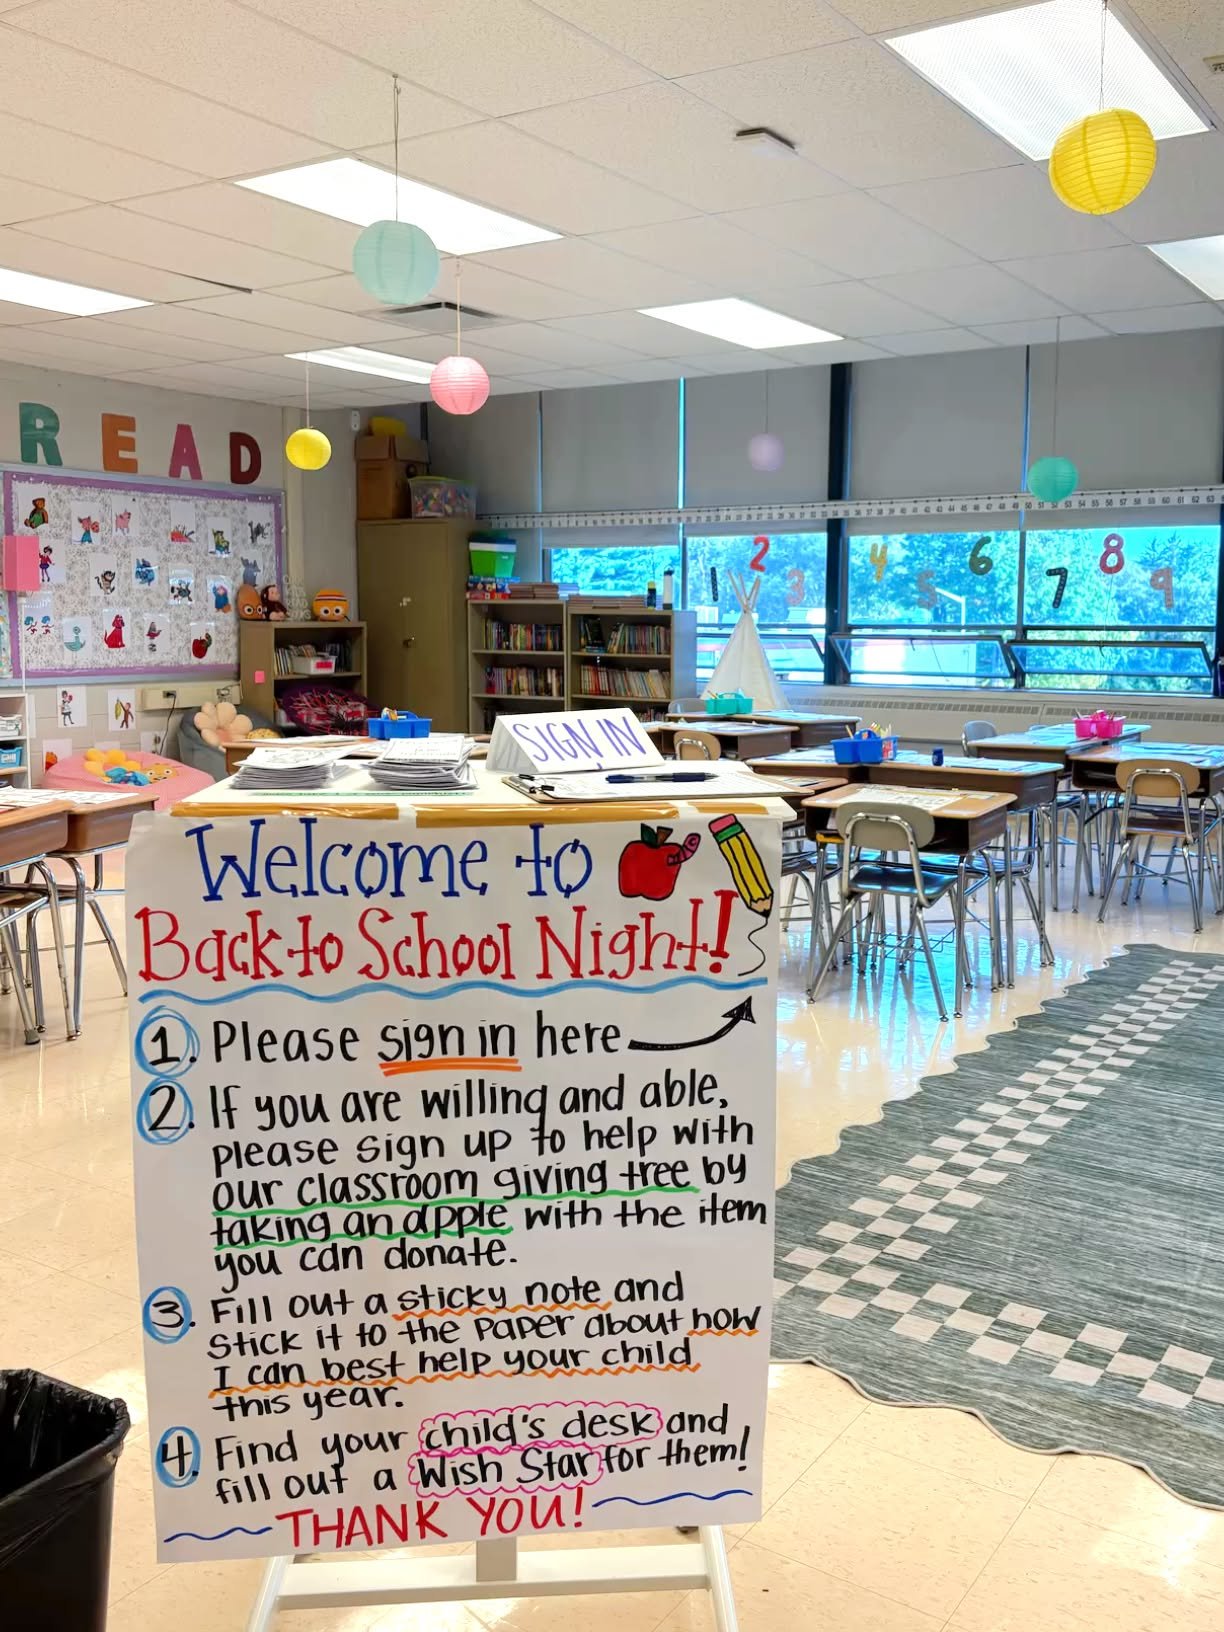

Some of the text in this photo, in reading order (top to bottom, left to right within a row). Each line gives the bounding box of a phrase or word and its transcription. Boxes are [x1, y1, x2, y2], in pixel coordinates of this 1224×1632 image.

[19, 402, 262, 485] READ
[1025, 501, 1033, 509] 50
[1038, 501, 1045, 509] 51
[1064, 500, 1072, 508] 53
[1078, 499, 1086, 507] 54
[1091, 499, 1100, 507] 55
[1105, 498, 1113, 507] 56
[1119, 498, 1127, 506] 57
[1162, 496, 1170, 504] 60
[1177, 496, 1184, 504] 61
[1191, 495, 1200, 503] 62
[750, 534, 770, 572] 2
[785, 568, 805, 605] 3
[870, 543, 888, 583] 4
[916, 569, 937, 610] 5
[968, 536, 993, 576] 6
[1046, 567, 1068, 609] 7
[1099, 533, 1124, 574] 8
[1149, 567, 1173, 609] 9
[513, 717, 647, 762] SIGN IN
[185, 817, 593, 901] Welcome to
[134, 889, 739, 982] Back to School Night!
[149, 1010, 621, 1065] 1. Please sign in here
[149, 1068, 728, 1131] 2. If you are willing and able,
[212, 1114, 754, 1178] please sign up to help with
[212, 1153, 747, 1212] our classroom giving tree by
[210, 1192, 767, 1247] taking an apple with the item
[215, 1237, 517, 1293] you can donate.
[152, 1271, 684, 1328] 3. Fill out a sticky note and
[316, 1323, 342, 1350] it
[356, 1322, 387, 1347] to
[397, 1318, 460, 1344] the
[584, 1308, 683, 1338] about
[692, 1305, 762, 1331] how
[214, 1336, 691, 1391] I can best help your child
[212, 1386, 404, 1422] this year.
[161, 1403, 728, 1477] 4. Find your child's desk and
[215, 1425, 750, 1504] fill out a Wish Star for them!
[275, 1486, 584, 1549] THANK YOU!
